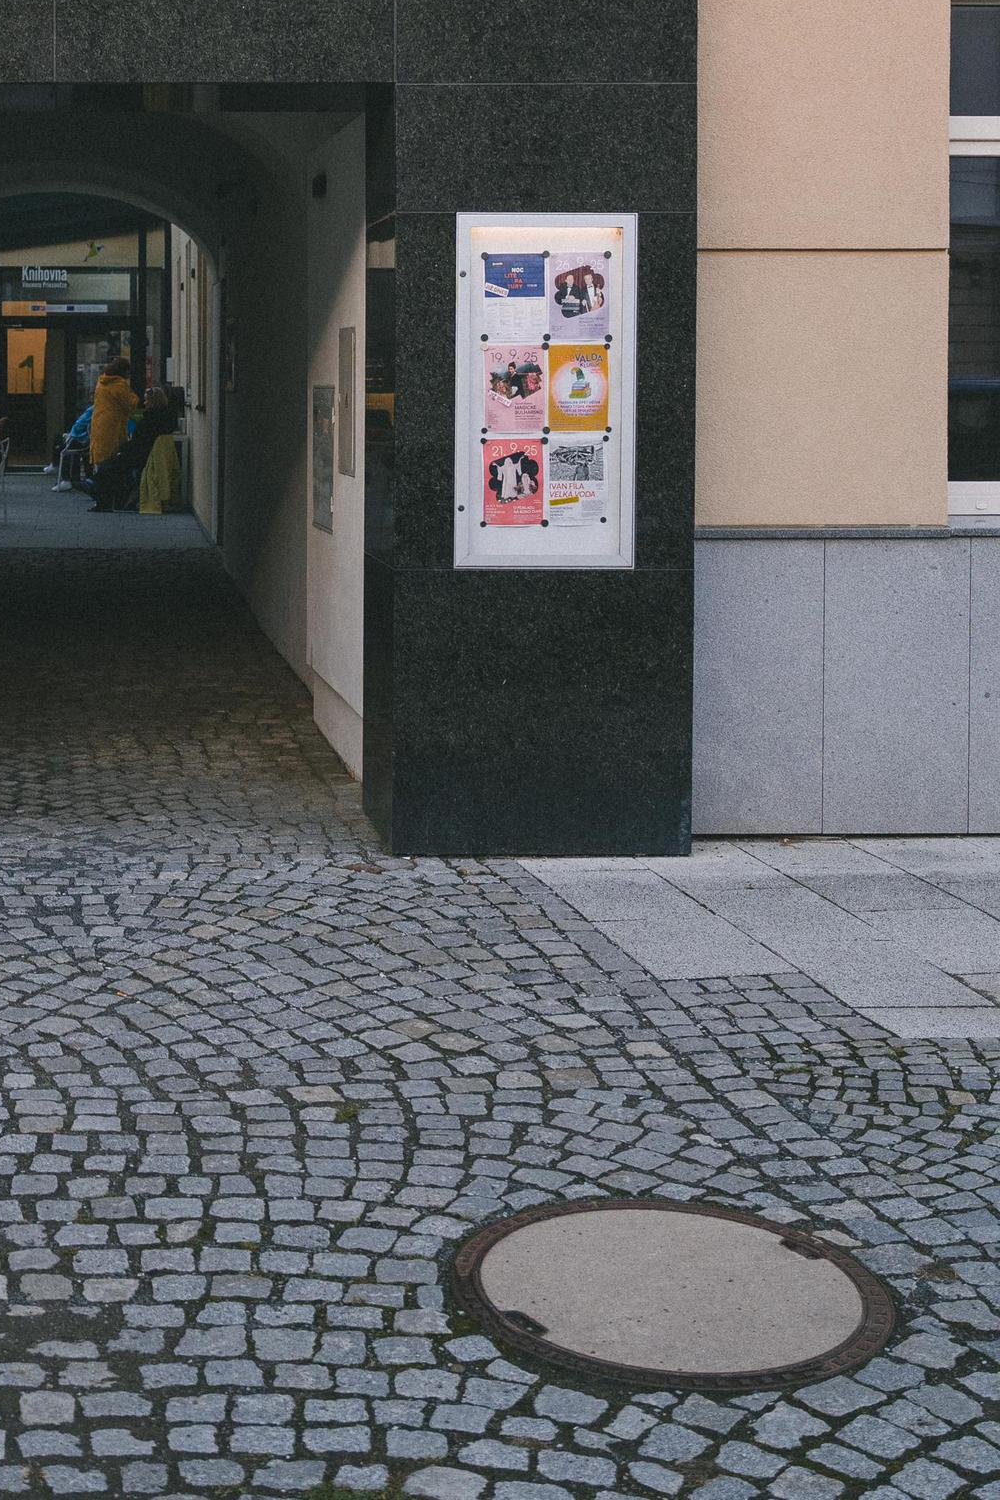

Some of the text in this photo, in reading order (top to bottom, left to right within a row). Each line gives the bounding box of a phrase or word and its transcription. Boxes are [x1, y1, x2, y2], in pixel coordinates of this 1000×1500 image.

[22, 265, 67, 281] Knihovna
[489, 348, 538, 363] 19. 9. 25
[491, 442, 538, 457] 21. 9. 25
[575, 490, 596, 498] VODA
